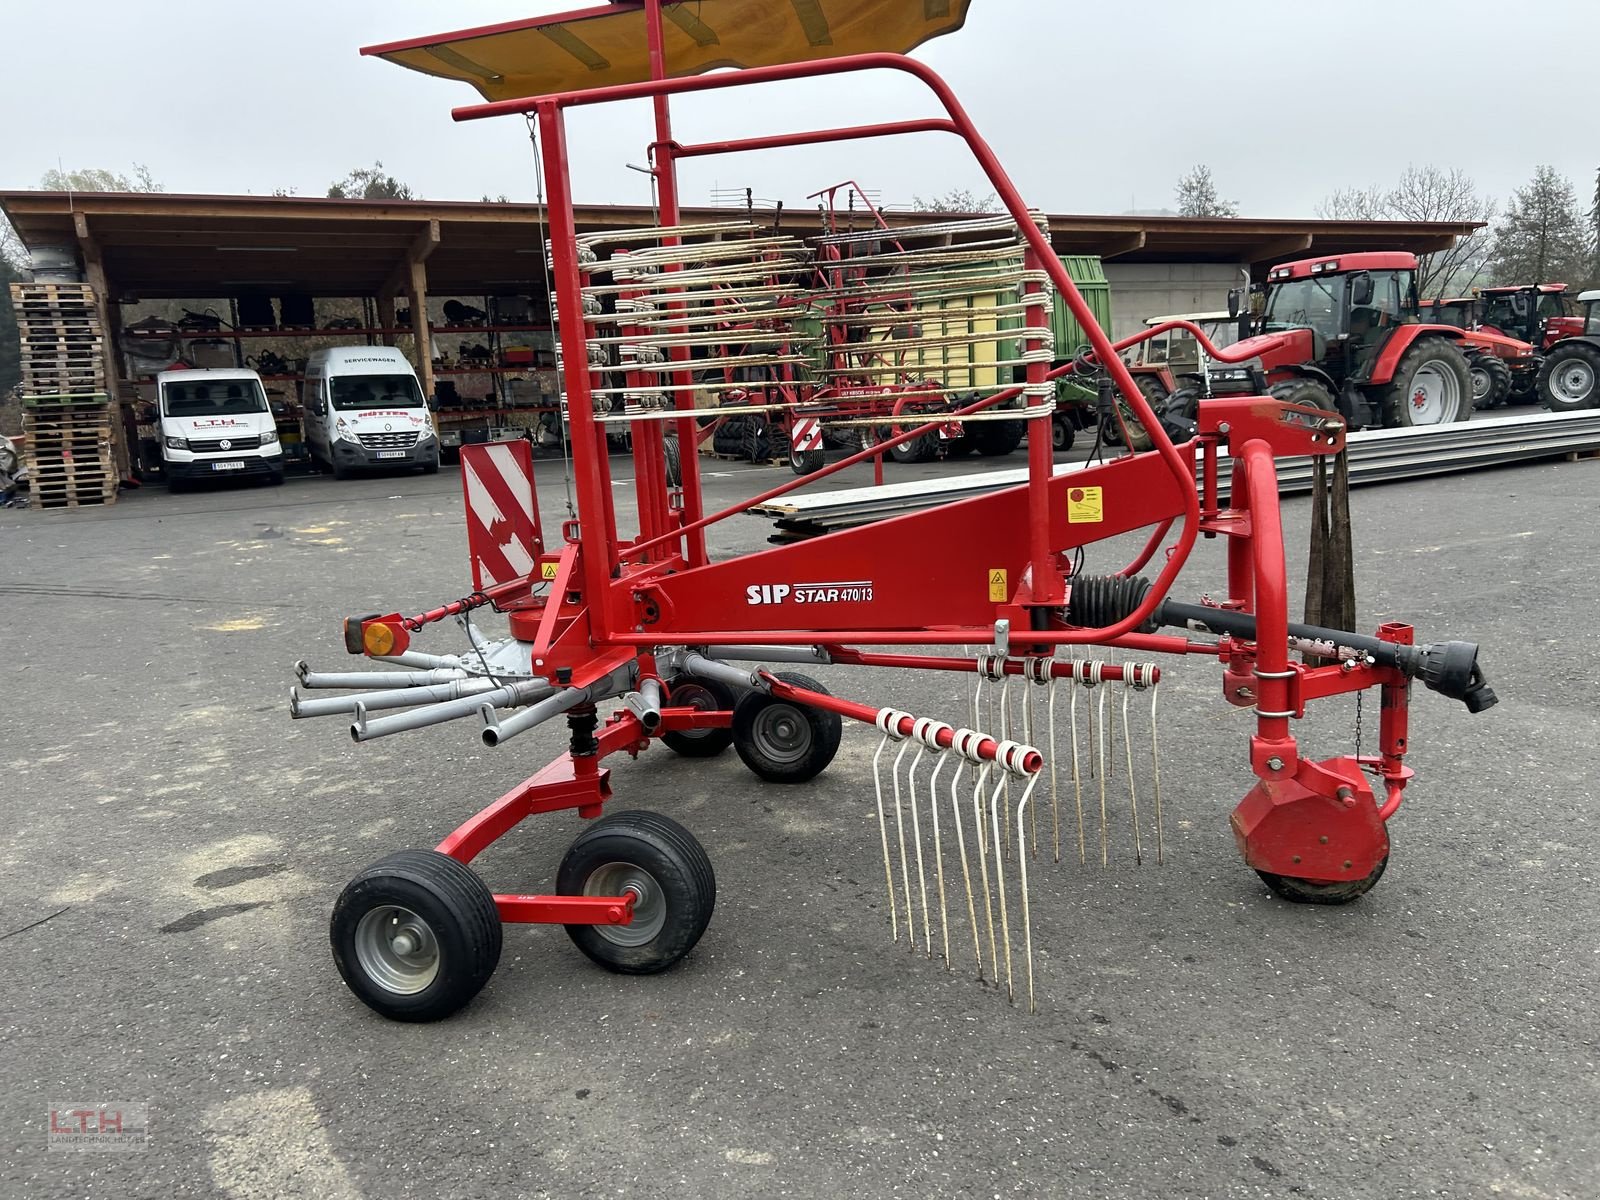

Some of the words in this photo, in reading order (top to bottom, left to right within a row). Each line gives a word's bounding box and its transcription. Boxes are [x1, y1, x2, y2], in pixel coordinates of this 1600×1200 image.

[193, 419, 235, 427] LTH
[746, 584, 790, 605] SIP
[794, 589, 838, 603] STAR
[840, 588, 873, 602] 470/13
